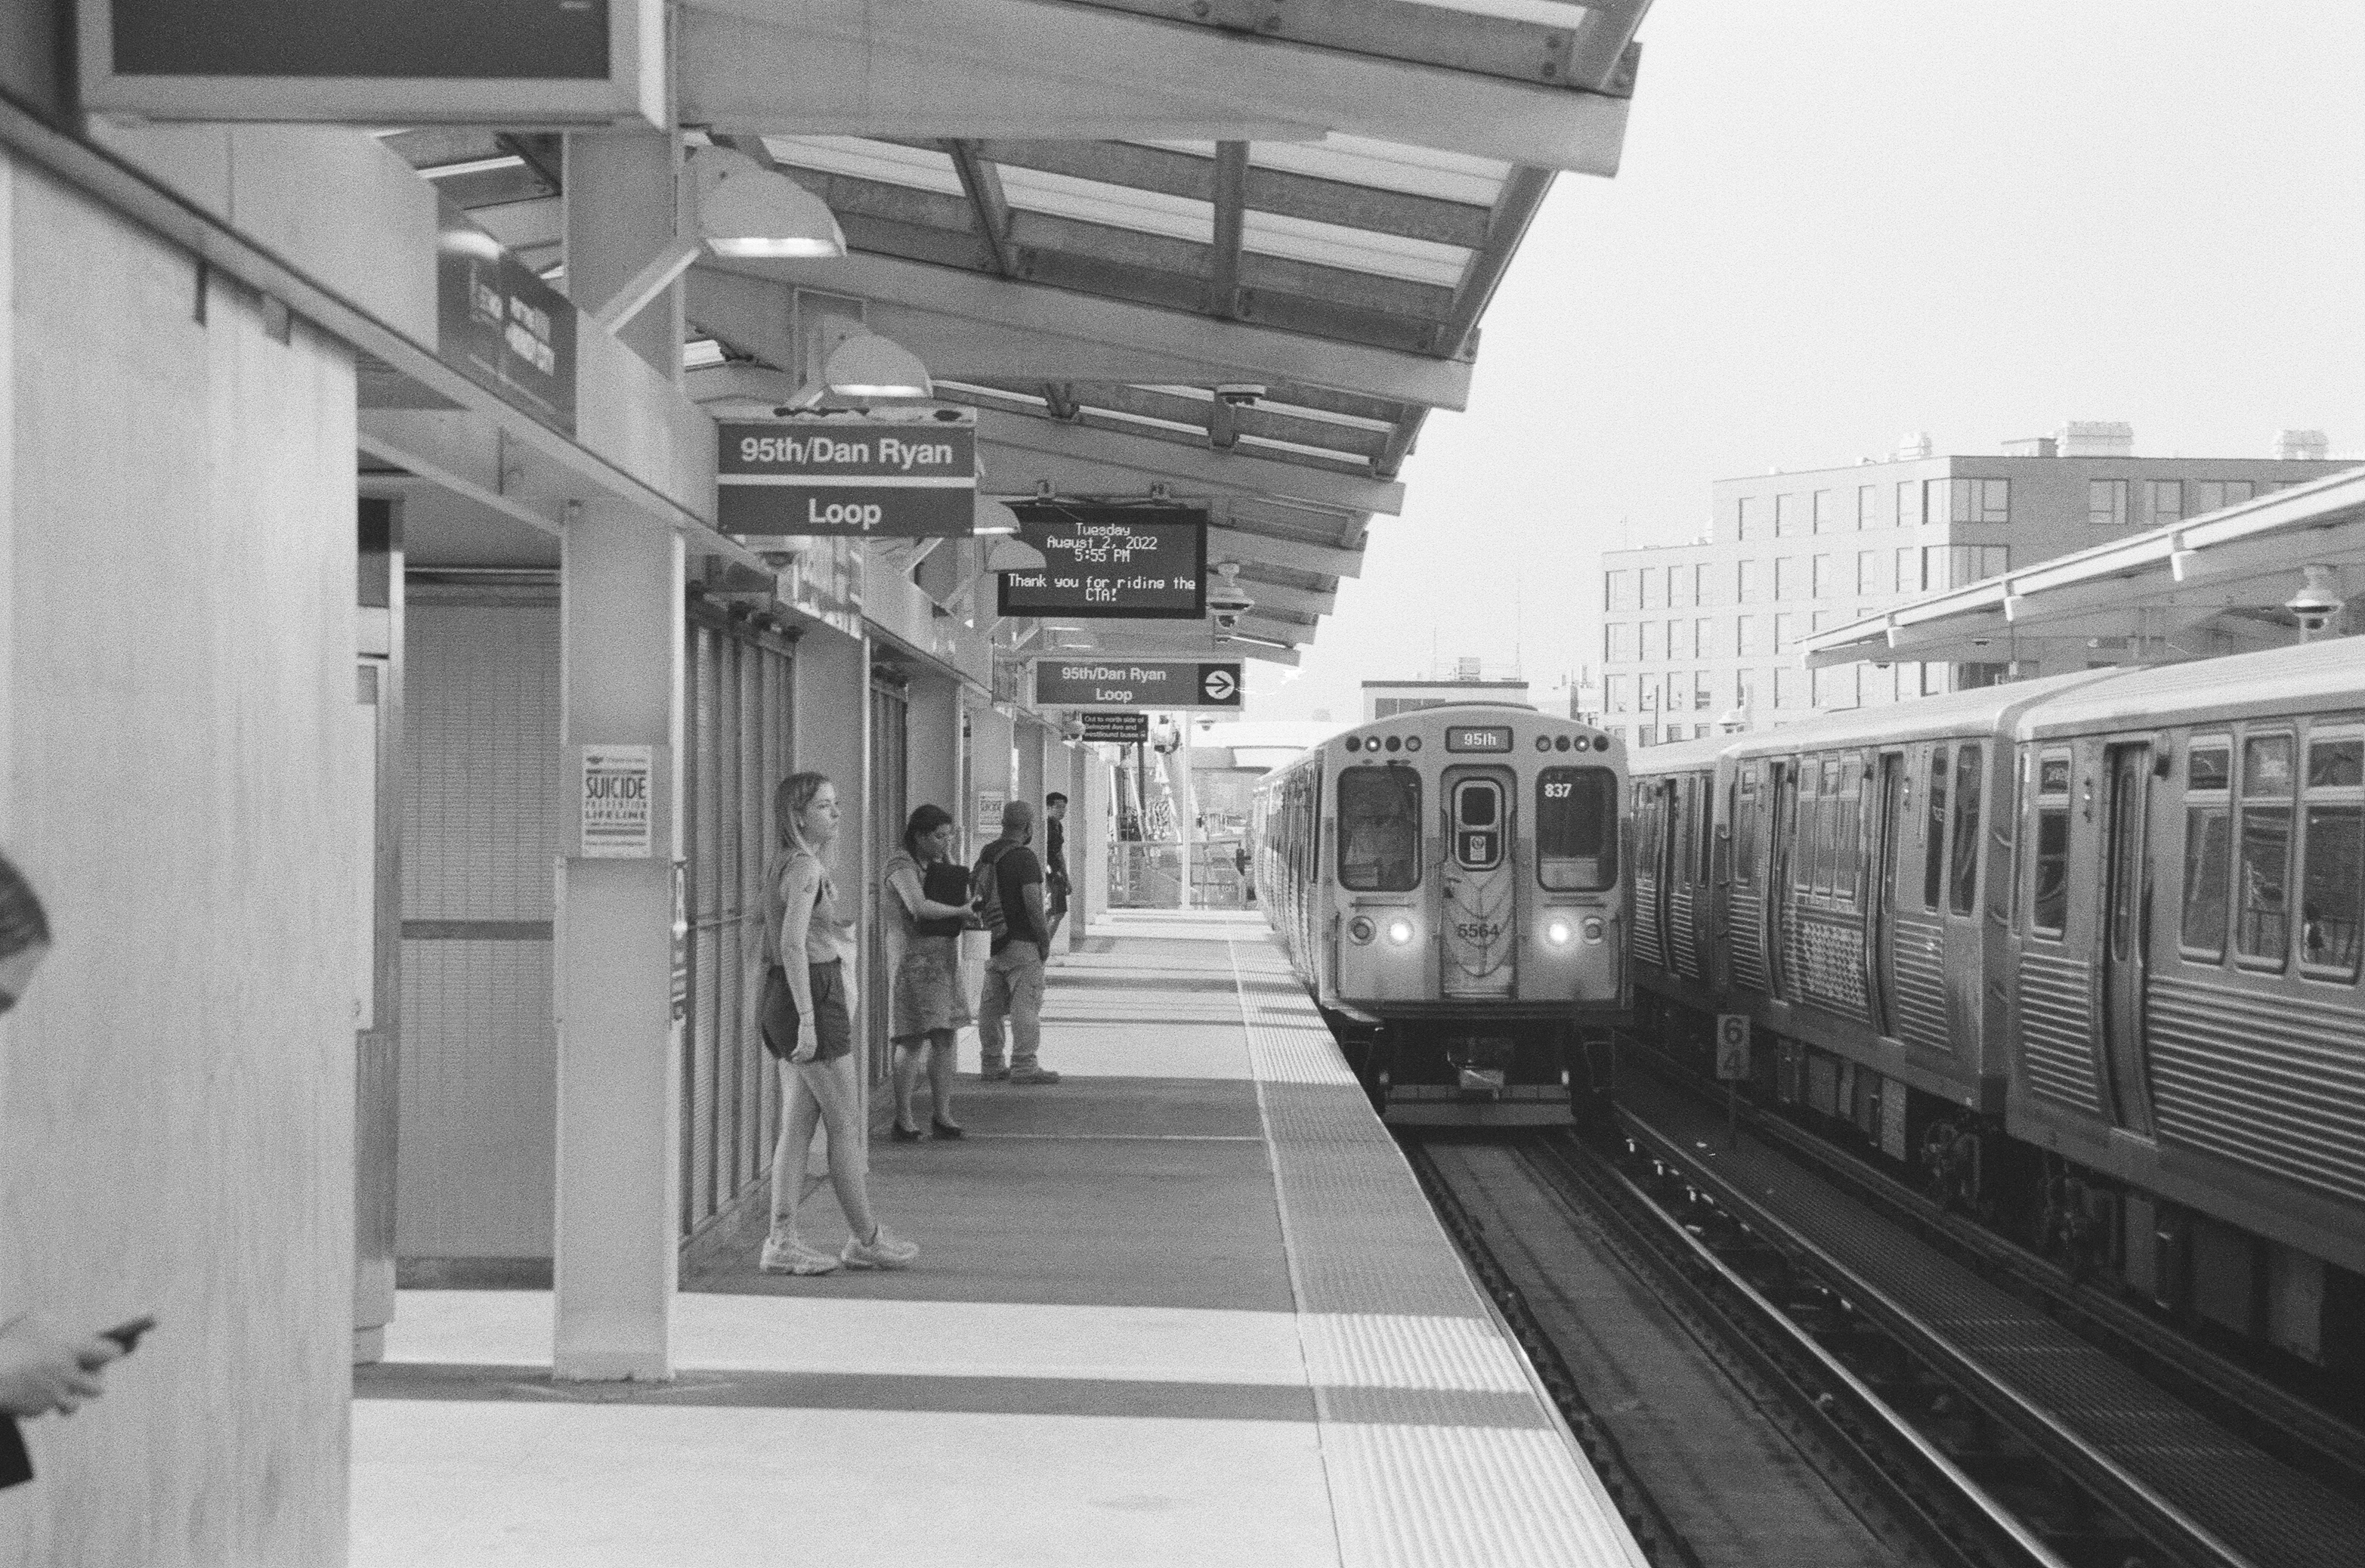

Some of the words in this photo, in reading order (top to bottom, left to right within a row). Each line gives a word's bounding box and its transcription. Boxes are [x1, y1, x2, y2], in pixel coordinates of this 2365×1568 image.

[740, 436, 869, 463] 95th/Dan
[880, 438, 953, 470] Ryan
[808, 497, 883, 530] Loop
[1075, 522, 1131, 536] Tuesday
[1046, 535, 1094, 549] August
[1102, 536, 1117, 549] 2,
[1126, 537, 1158, 549] 2022
[1074, 549, 1106, 562] 5:55
[1113, 549, 1130, 562] PM
[1007, 573, 1047, 587] Thank
[1054, 578, 1079, 589] you
[1086, 576, 1110, 589] for
[1117, 577, 1165, 589] riding
[1173, 577, 1196, 589] the
[1085, 588, 1117, 602] CTA!
[1062, 666, 1126, 681] 95th/Dan
[1130, 667, 1167, 683] Ryan
[1096, 688, 1133, 704] Loop
[586, 776, 647, 799] SUICIDE
[1544, 783, 1572, 798] 837
